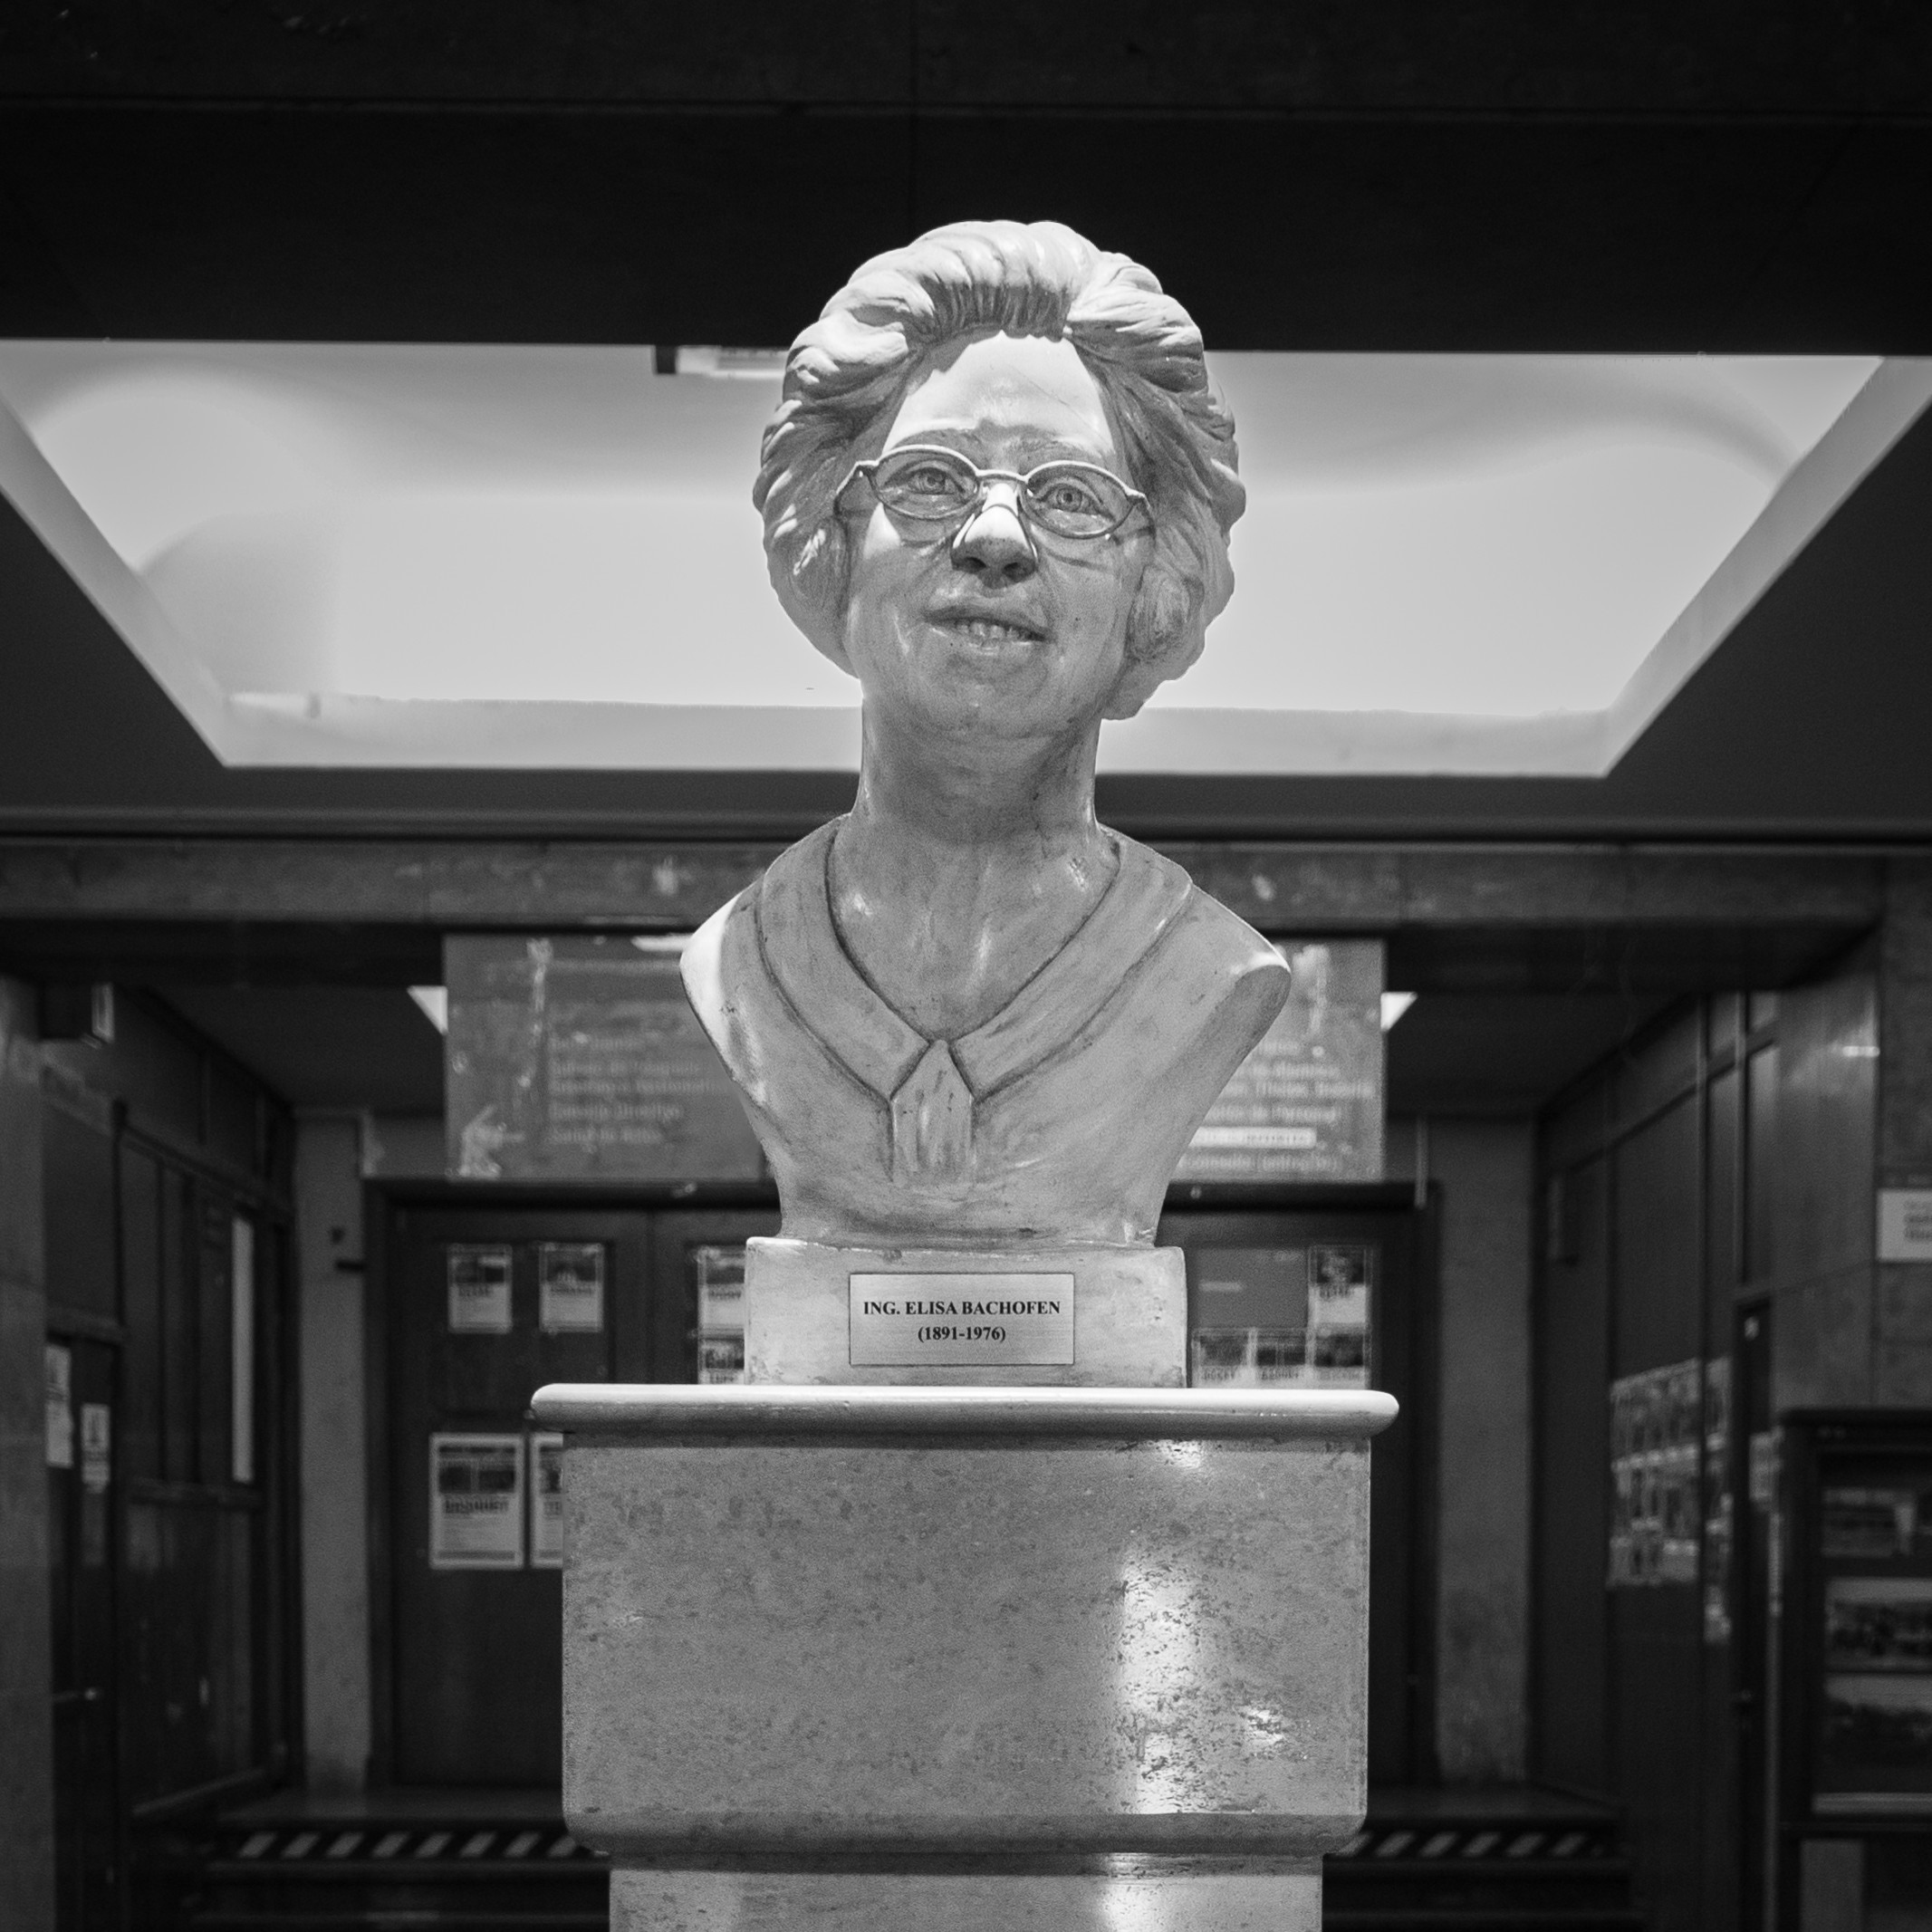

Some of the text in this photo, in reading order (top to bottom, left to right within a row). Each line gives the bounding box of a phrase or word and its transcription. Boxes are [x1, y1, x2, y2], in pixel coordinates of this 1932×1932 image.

[863, 1301, 1061, 1314] ING. ELISA BACHOFEN
[918, 1326, 1006, 1342] (1891-1976)
